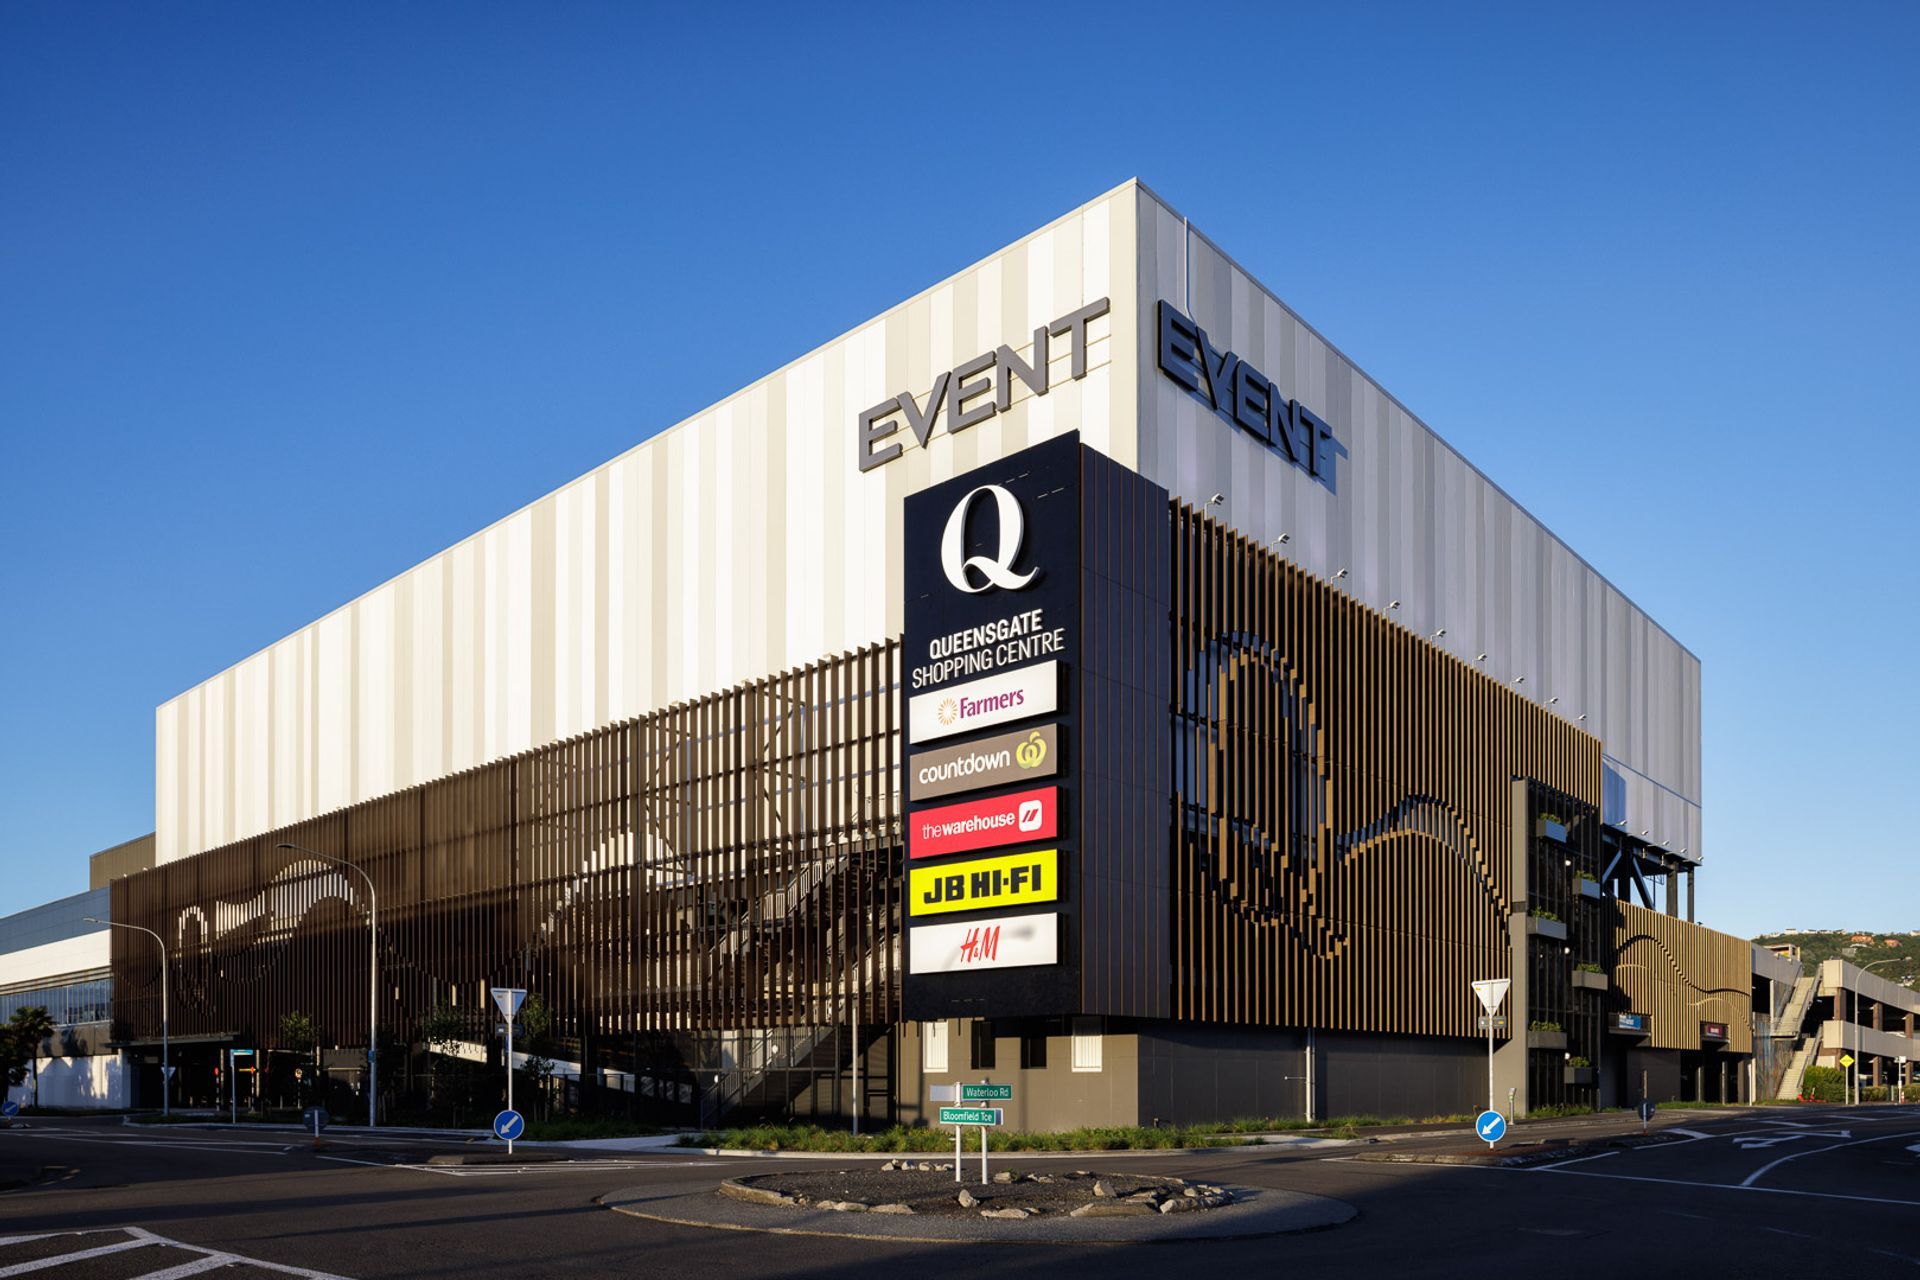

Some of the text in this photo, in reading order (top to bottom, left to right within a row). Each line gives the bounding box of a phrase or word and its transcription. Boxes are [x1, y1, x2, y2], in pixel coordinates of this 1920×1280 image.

[859, 297, 1110, 473] EVENT
[1158, 299, 1332, 475] EVENT
[941, 484, 1040, 593] Q
[929, 609, 1043, 660] QUEENSGATE
[911, 628, 1066, 689] SHOPPING CENTRE
[960, 689, 1025, 719] Farmers
[919, 750, 1011, 785] countdown
[924, 874, 965, 904] JB
[960, 925, 1001, 963] H&M
[966, 1087, 1009, 1097] Waterloo Rd
[943, 1111, 992, 1122] Bloomfield Tce
